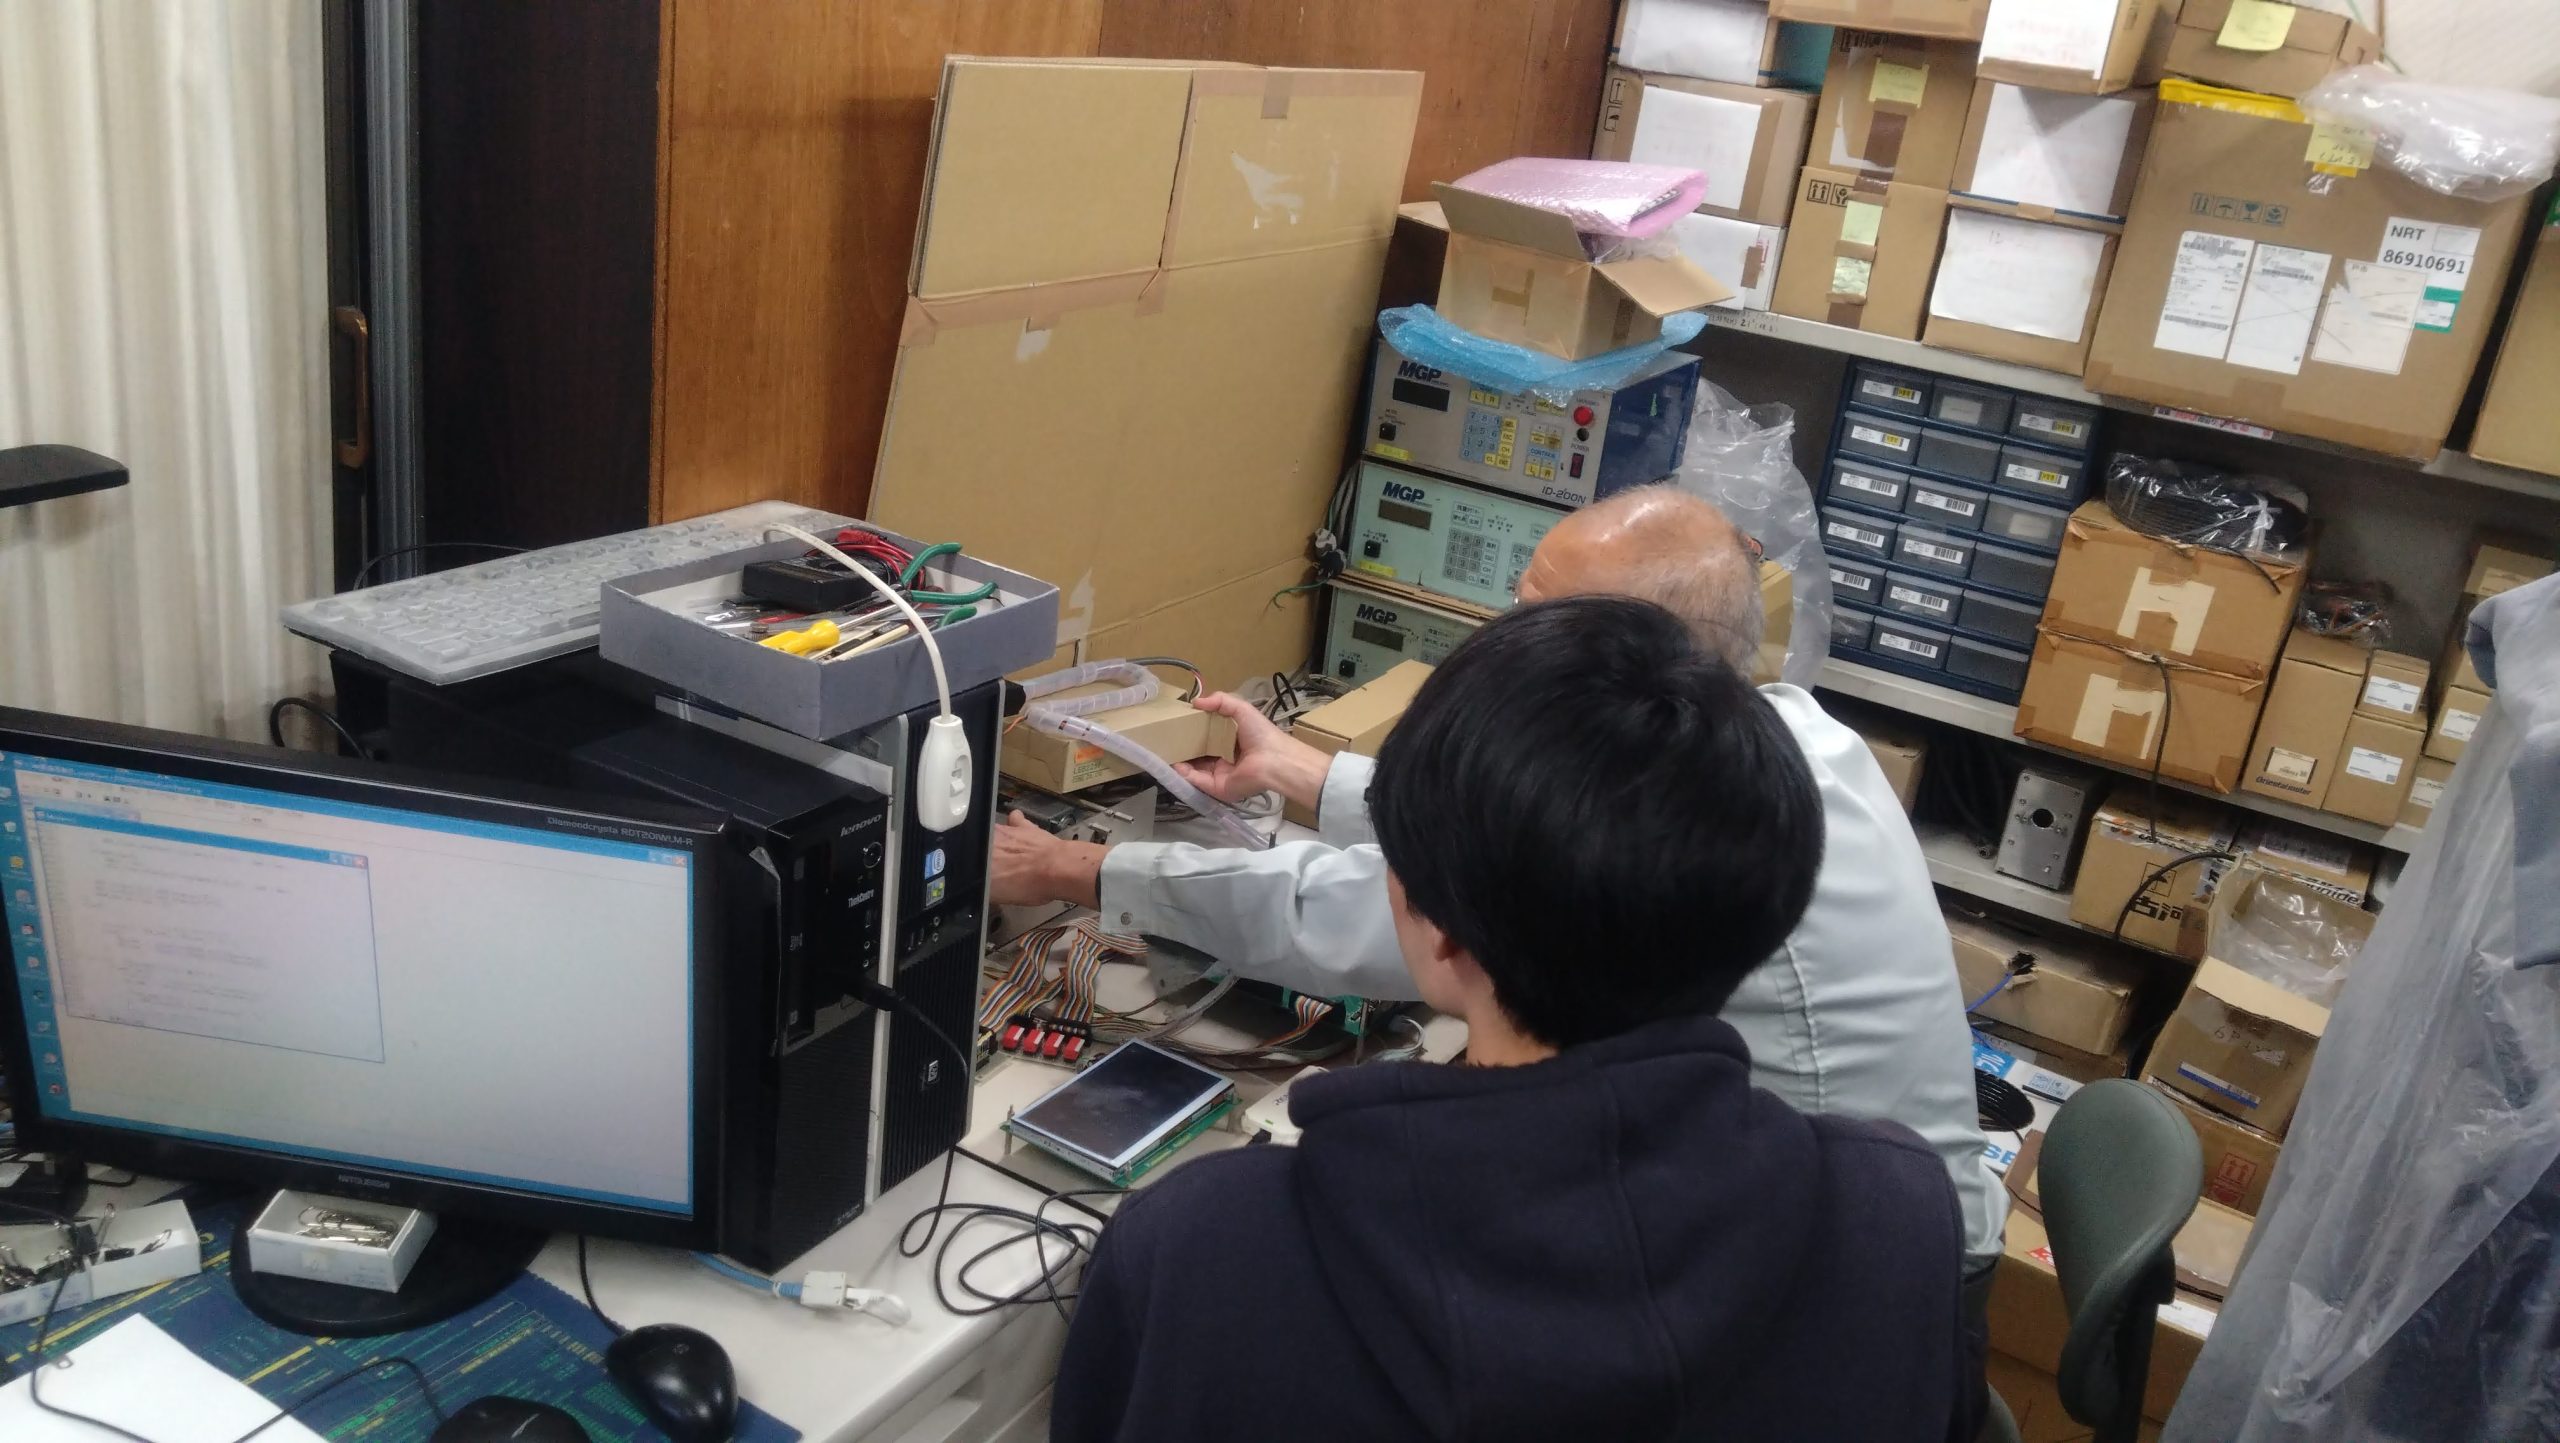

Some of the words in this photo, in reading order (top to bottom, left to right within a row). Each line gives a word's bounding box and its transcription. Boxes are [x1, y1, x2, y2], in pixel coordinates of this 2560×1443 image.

[2390, 225, 2426, 241] NRT
[2383, 249, 2466, 275] 86910691
[1398, 360, 1442, 382] MGP
[1382, 481, 1425, 503] MGP
[1541, 485, 1587, 505] ID-200N
[1355, 603, 1398, 625] MGP
[840, 814, 882, 837] lenovo
